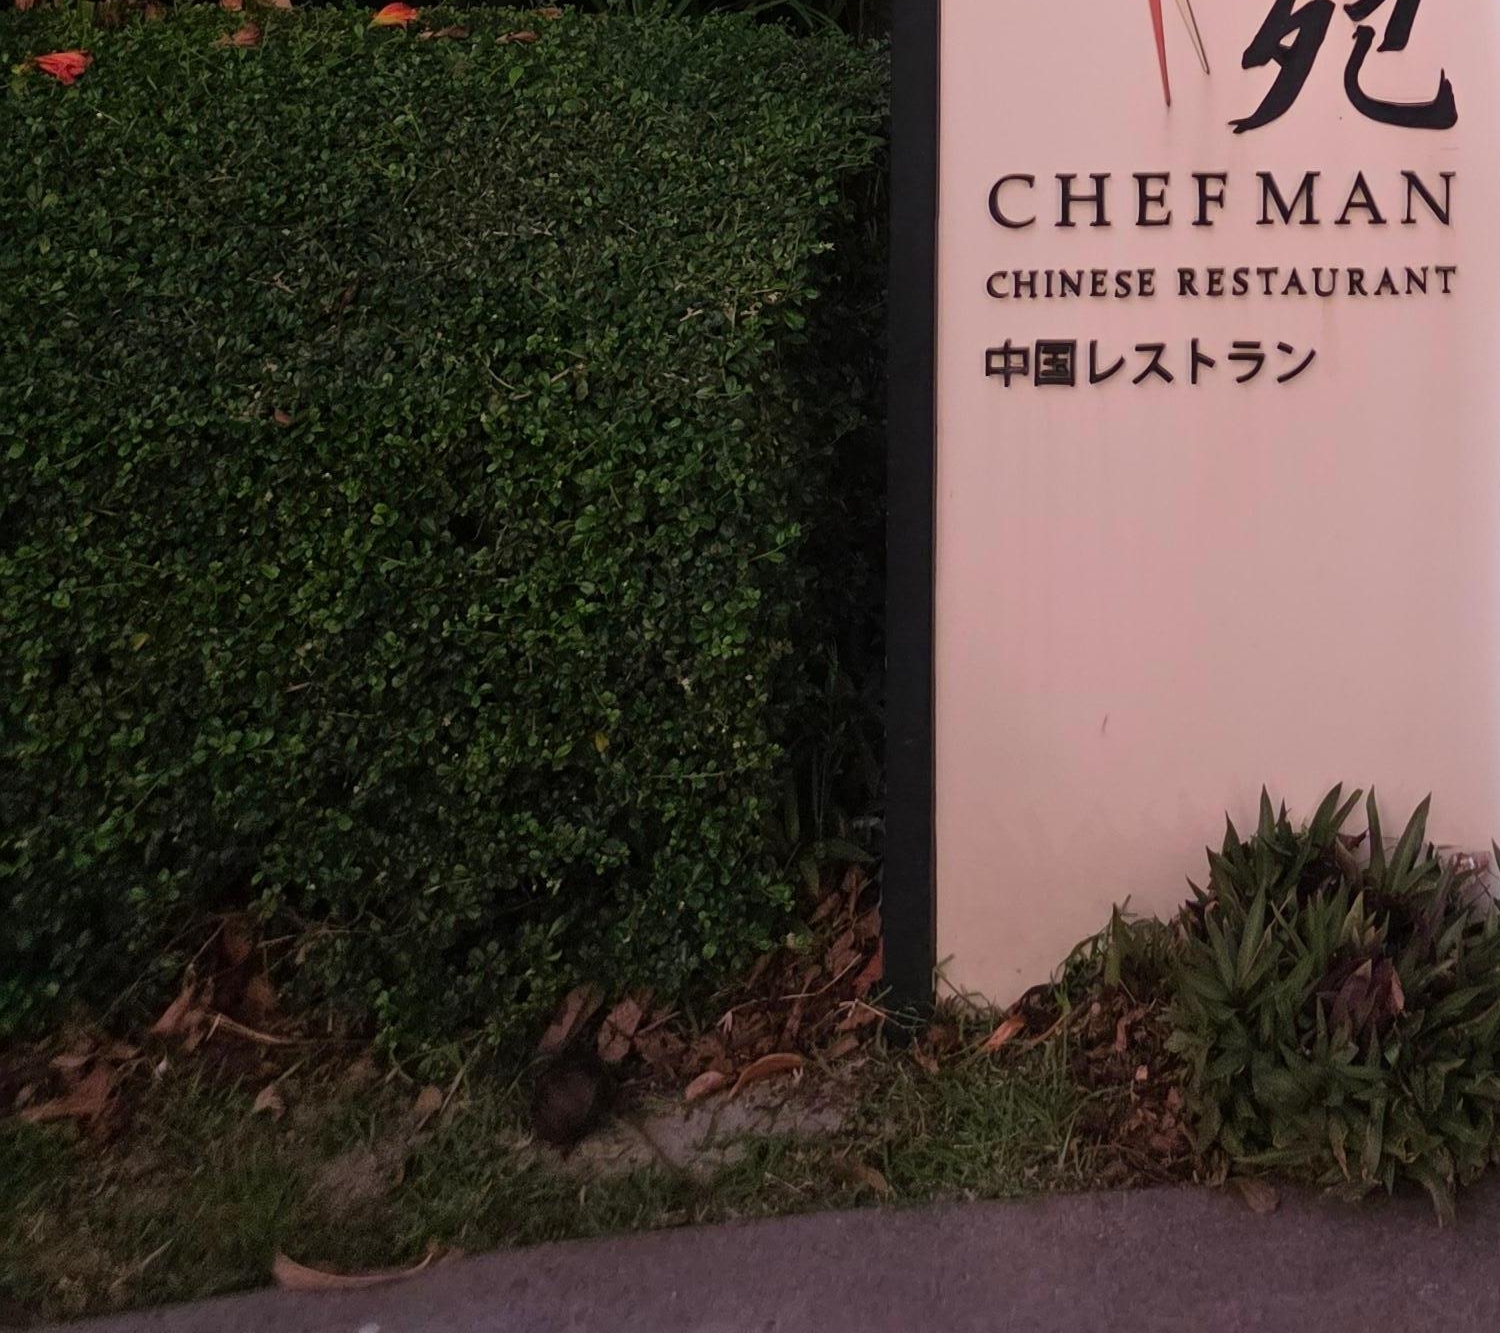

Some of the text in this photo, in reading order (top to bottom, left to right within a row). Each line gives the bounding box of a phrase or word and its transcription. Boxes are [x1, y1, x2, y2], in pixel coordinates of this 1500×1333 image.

[985, 264, 1458, 300] CHINESE RESTAURANT
[983, 336, 1318, 388] 中国レストラン
